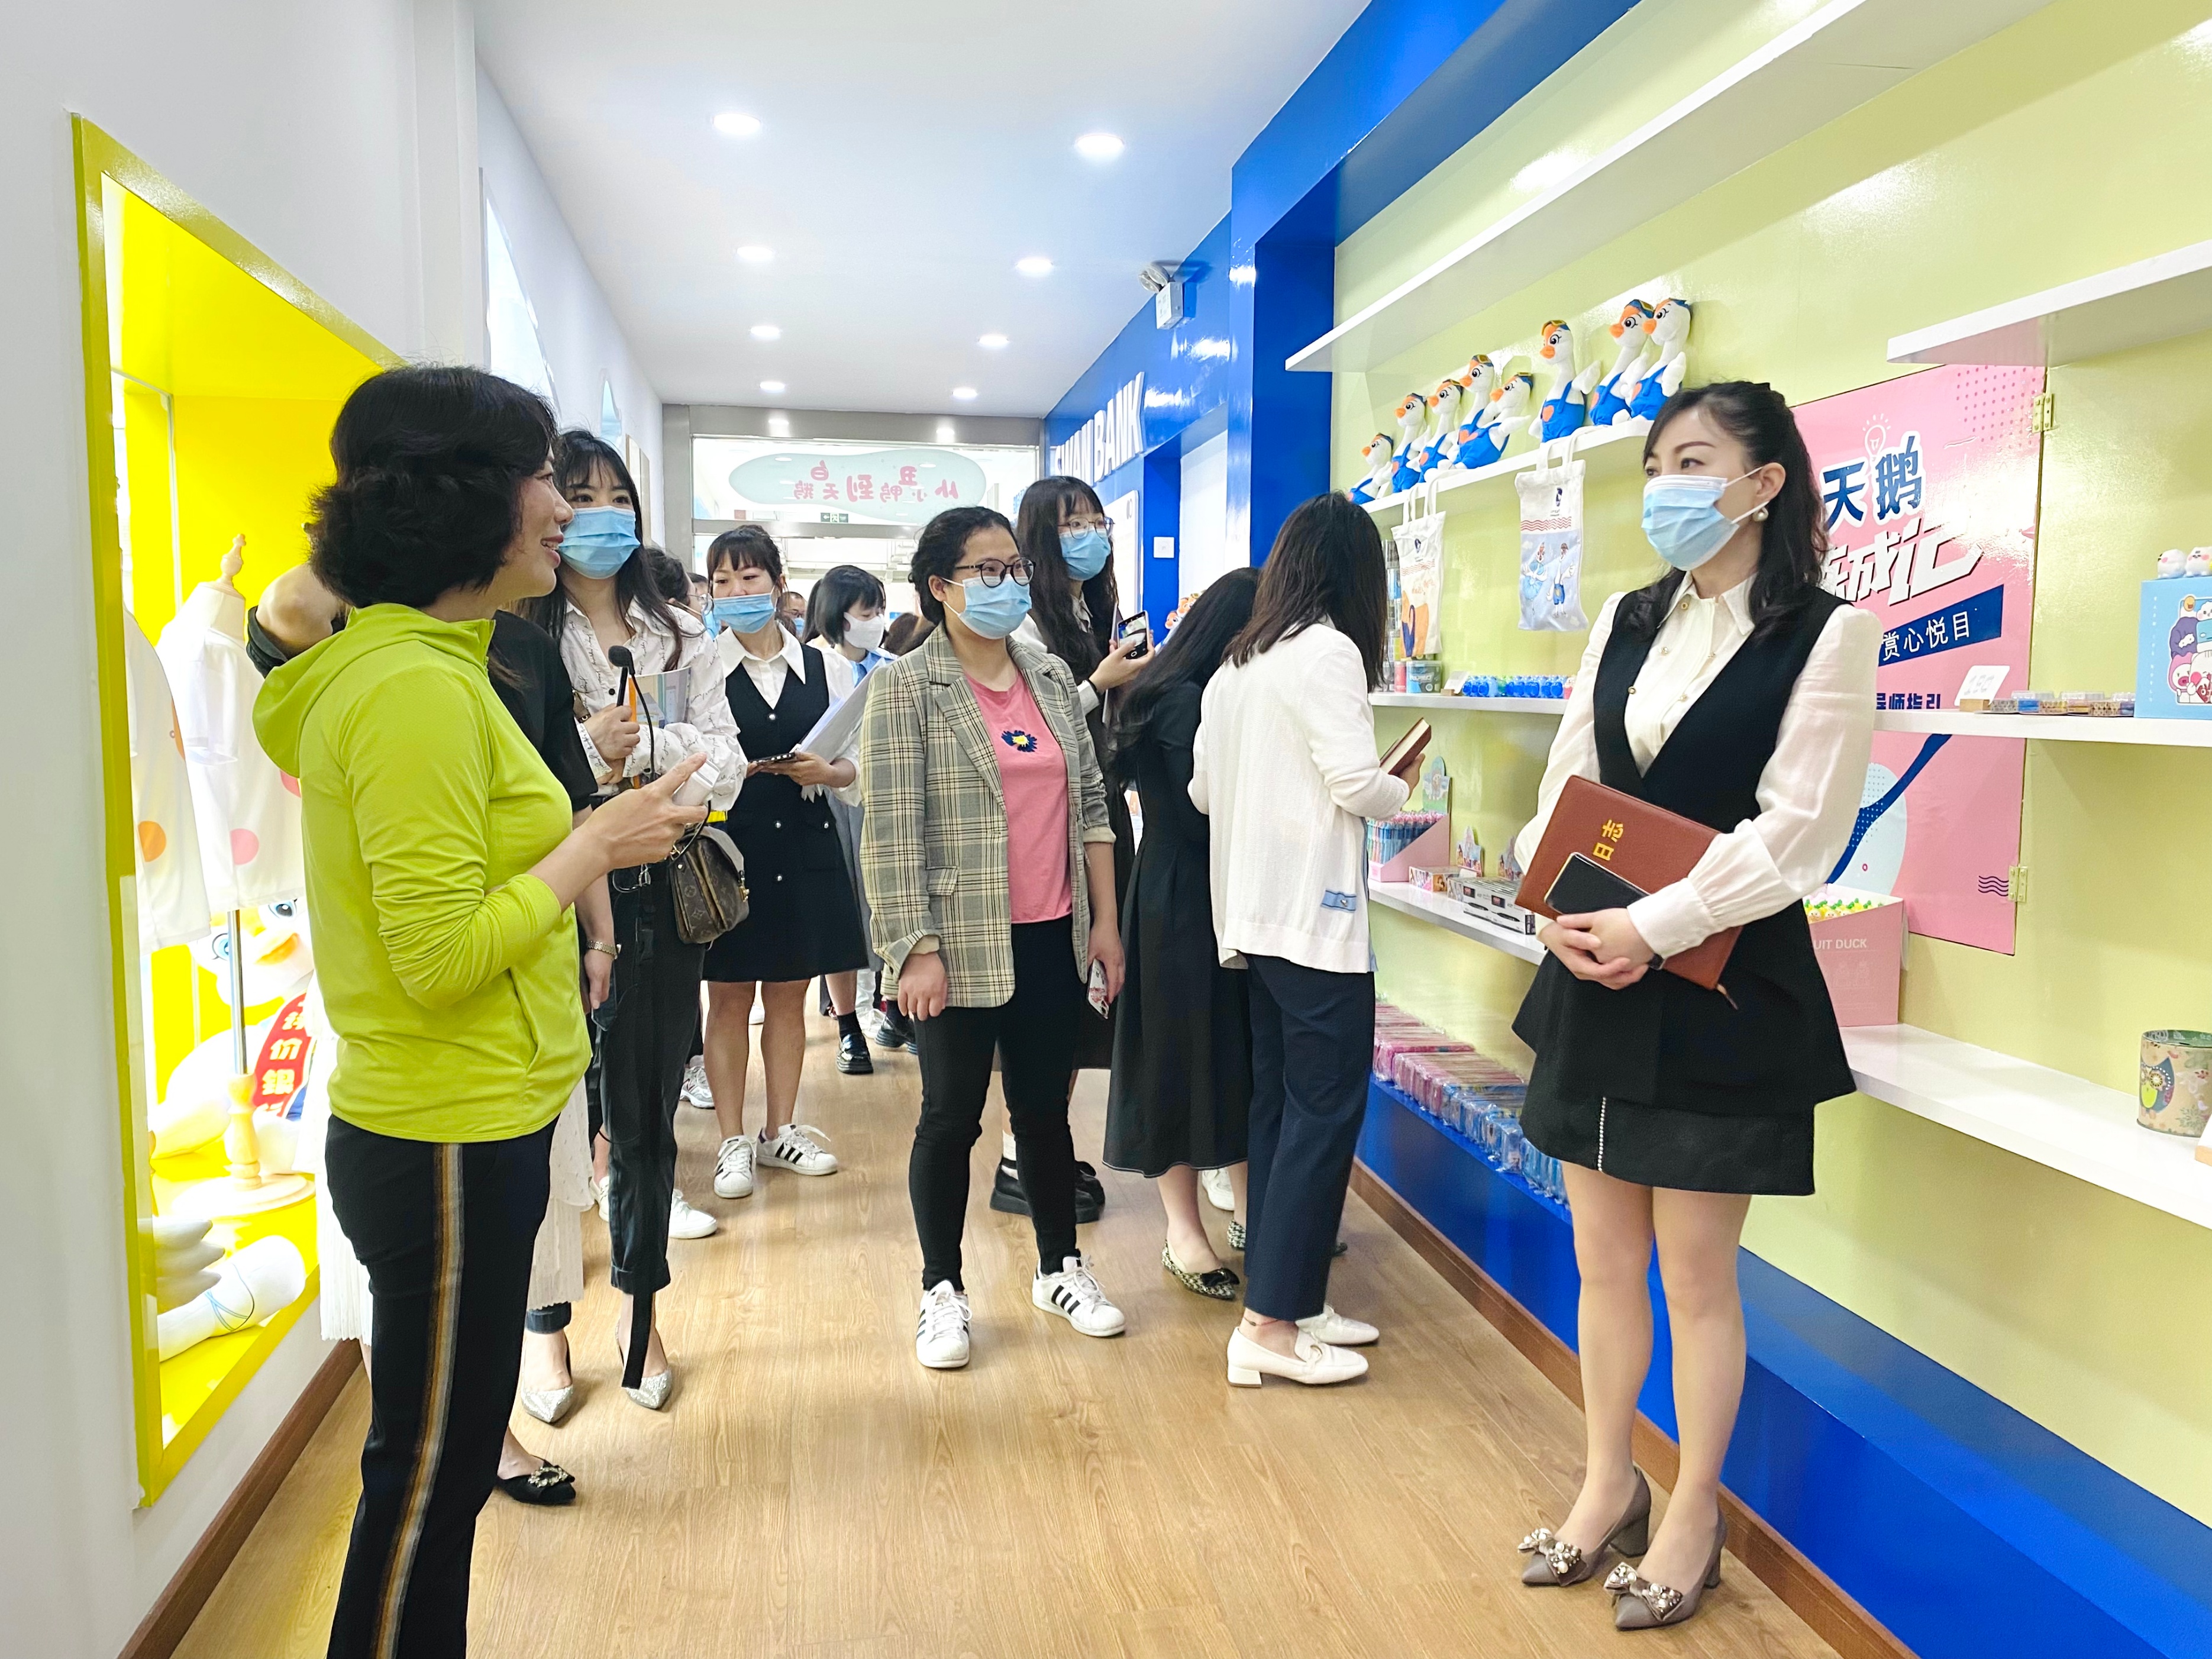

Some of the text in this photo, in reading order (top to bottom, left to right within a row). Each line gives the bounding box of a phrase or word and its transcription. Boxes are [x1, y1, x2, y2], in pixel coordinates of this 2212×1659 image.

[1094, 372, 1145, 482] BANK
[1823, 436, 1922, 530] 天鹅
[1881, 611, 1969, 661] 赏心悦目
[1593, 819, 1624, 861] 日志
[1835, 938, 1867, 949] DUCK
